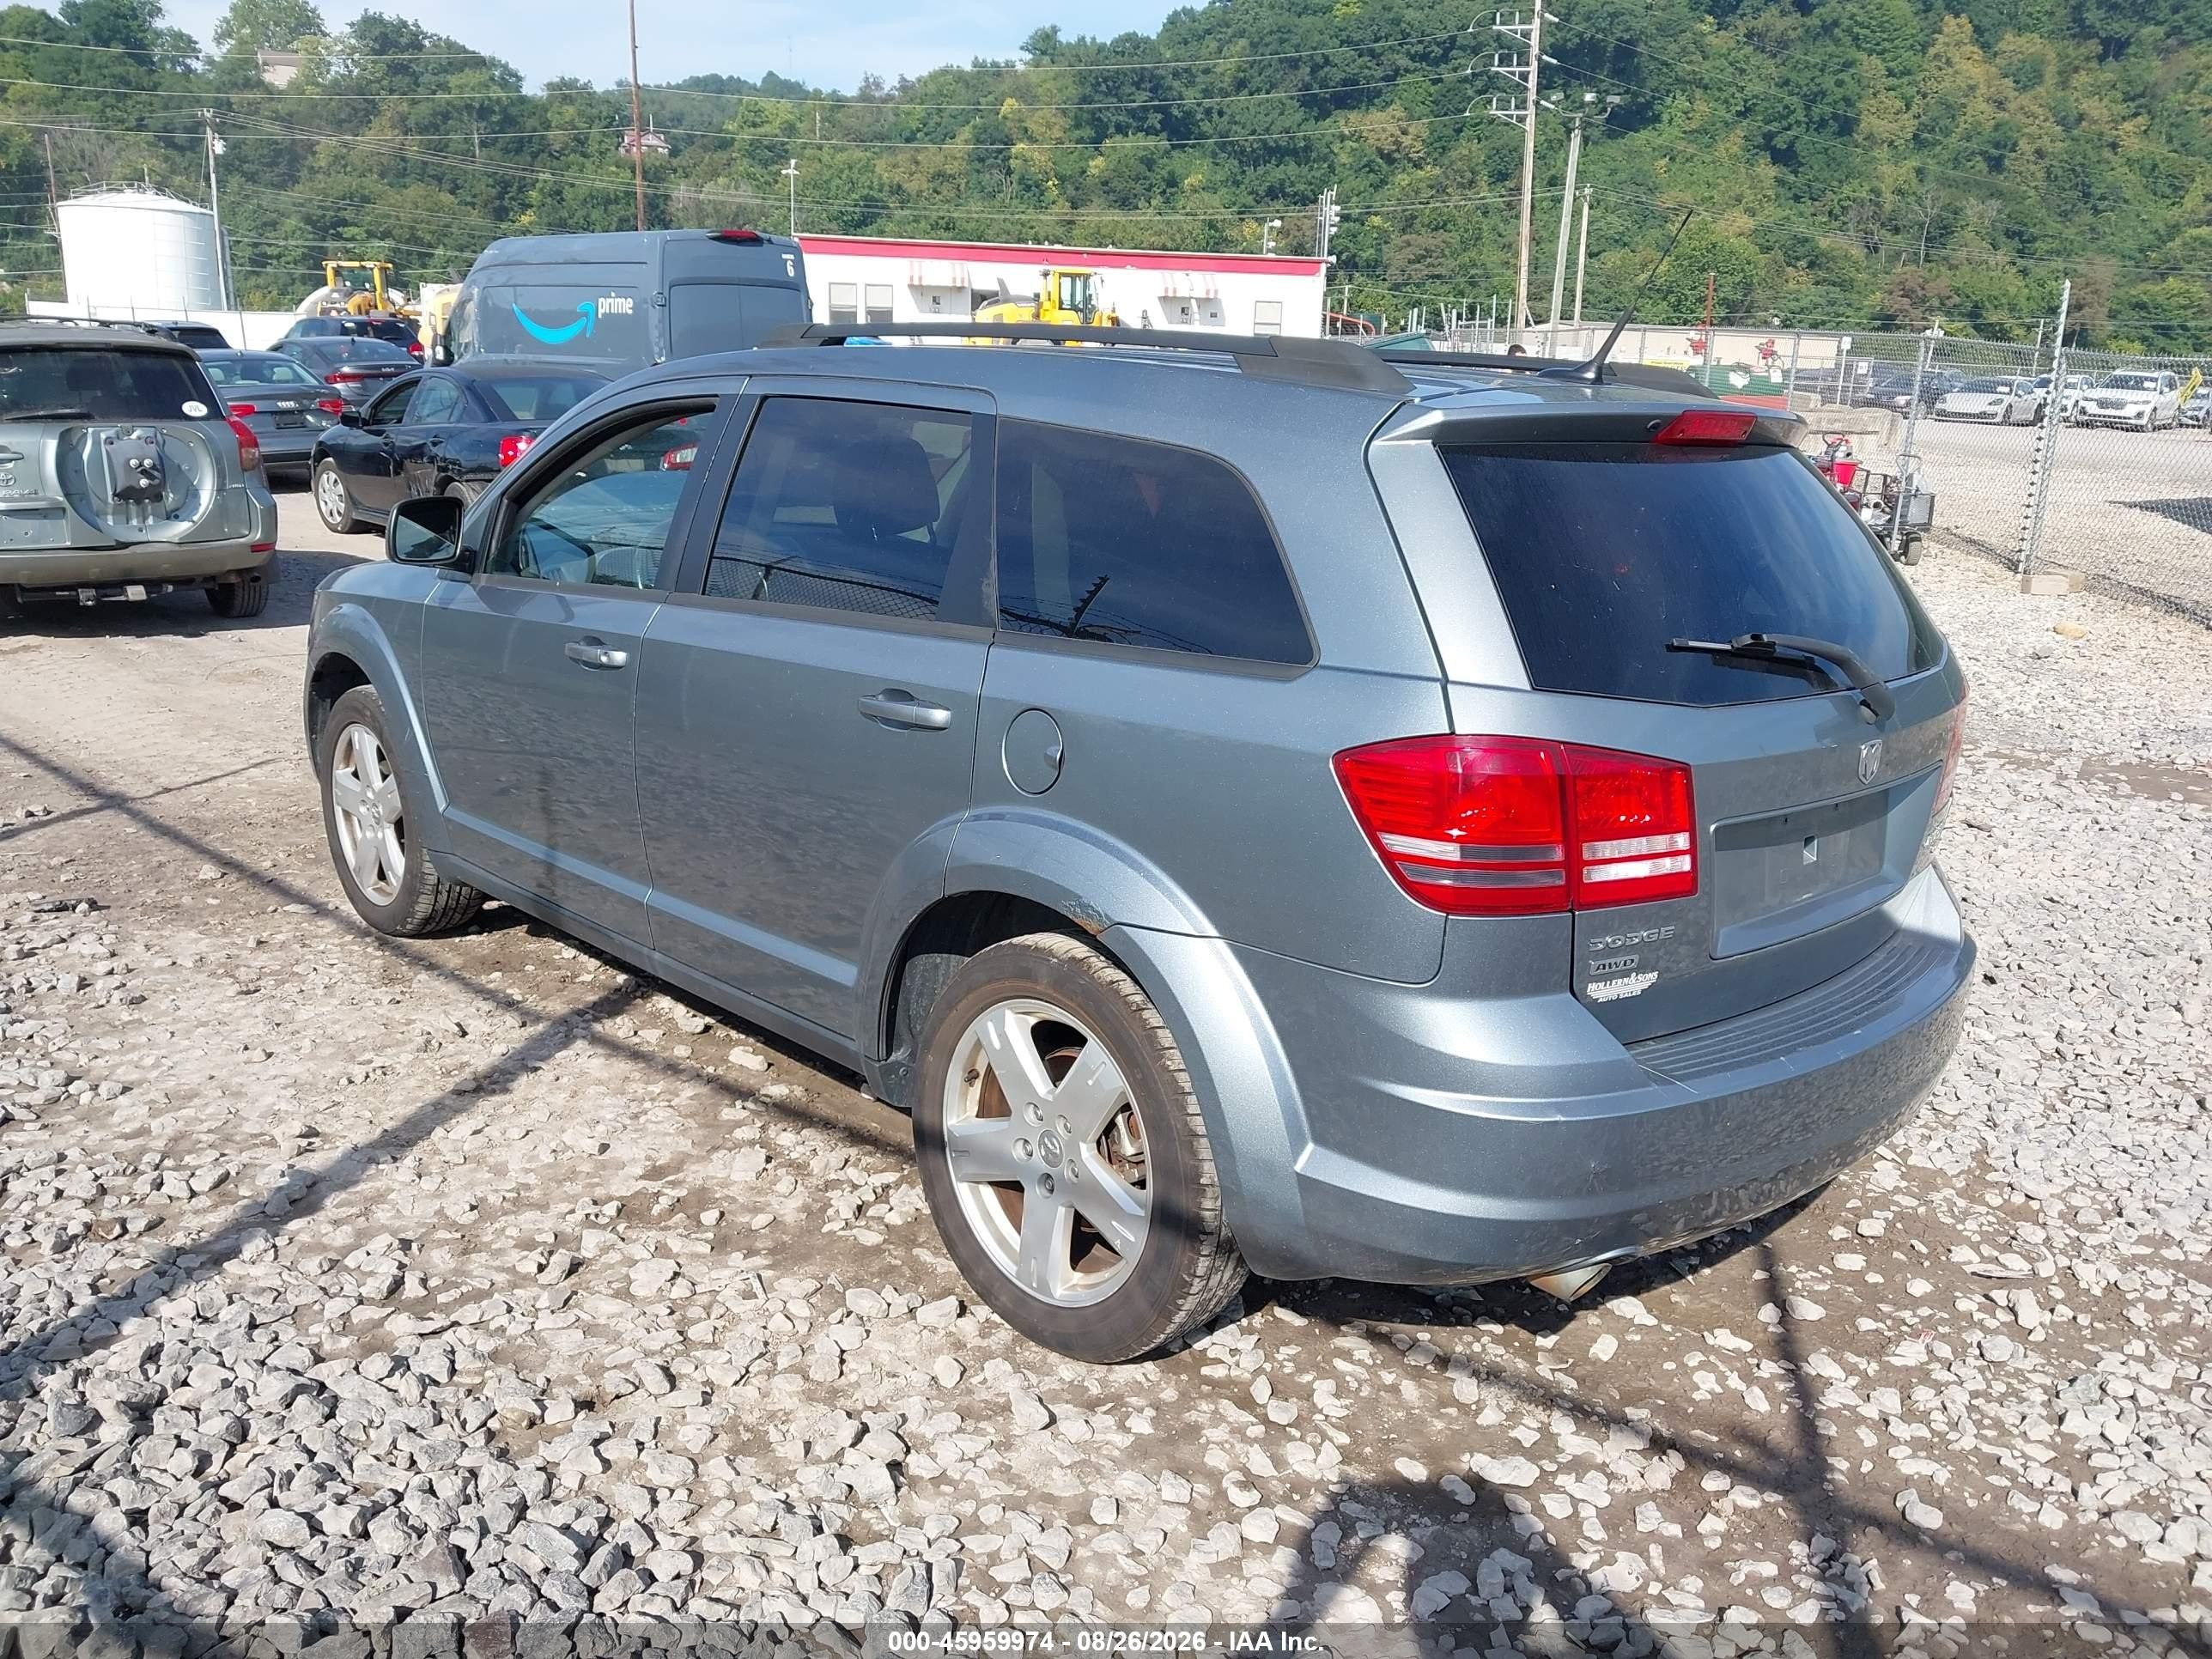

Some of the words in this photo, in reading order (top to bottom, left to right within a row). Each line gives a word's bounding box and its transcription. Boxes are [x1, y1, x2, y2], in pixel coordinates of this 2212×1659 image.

[786, 259, 795, 277] 6
[598, 291, 633, 319] prime
[1588, 926, 1675, 951] DODGE
[1595, 958, 1635, 973] AWD
[1597, 994, 1619, 1003] AUTO
[1619, 989, 1643, 999] SALES
